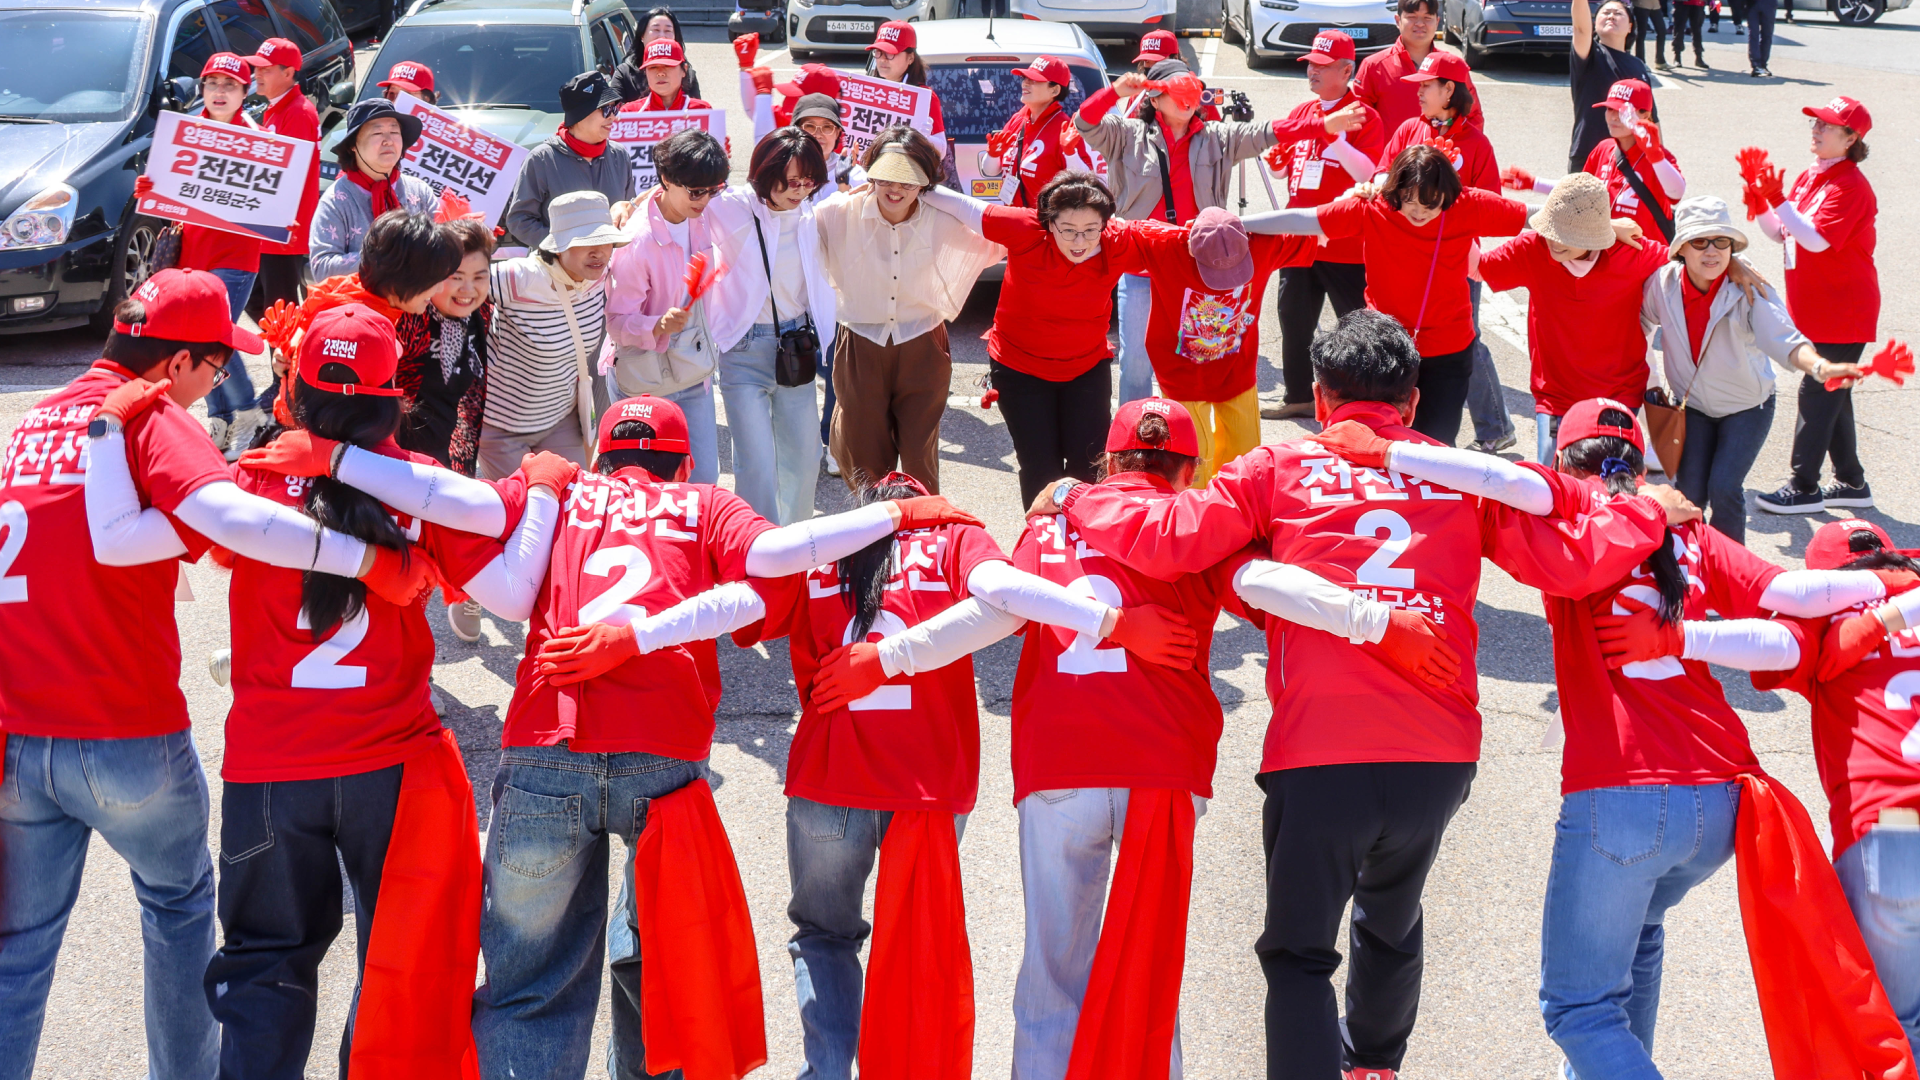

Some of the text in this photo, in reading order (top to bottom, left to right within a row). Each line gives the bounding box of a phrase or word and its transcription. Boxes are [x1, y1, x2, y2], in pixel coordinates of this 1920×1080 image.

[850, 22, 871, 31] 3756
[740, 42, 748, 54] 2
[212, 55, 241, 73] 2전진선
[839, 80, 911, 111] 양평군수 후보
[417, 111, 504, 164] 양평군수 후보
[609, 121, 670, 139] 양평군수
[182, 126, 286, 163] 양평군수 후보
[995, 142, 1002, 152] 2
[1021, 139, 1045, 172] 2
[170, 149, 199, 177] 2
[418, 142, 498, 196] 전진선
[1275, 155, 1283, 165] 2
[197, 155, 284, 195] 전진선
[156, 202, 189, 216] 국민의힘
[201, 187, 262, 211] 양평군수
[322, 338, 358, 360] 2전진선
[62, 404, 96, 427] 후보
[621, 404, 653, 419] 2전진선
[1354, 508, 1415, 590] 2
[578, 545, 648, 626] 2
[1352, 587, 1445, 625] 평군수 후보
[1056, 575, 1128, 675] 2
[291, 599, 370, 690] 2
